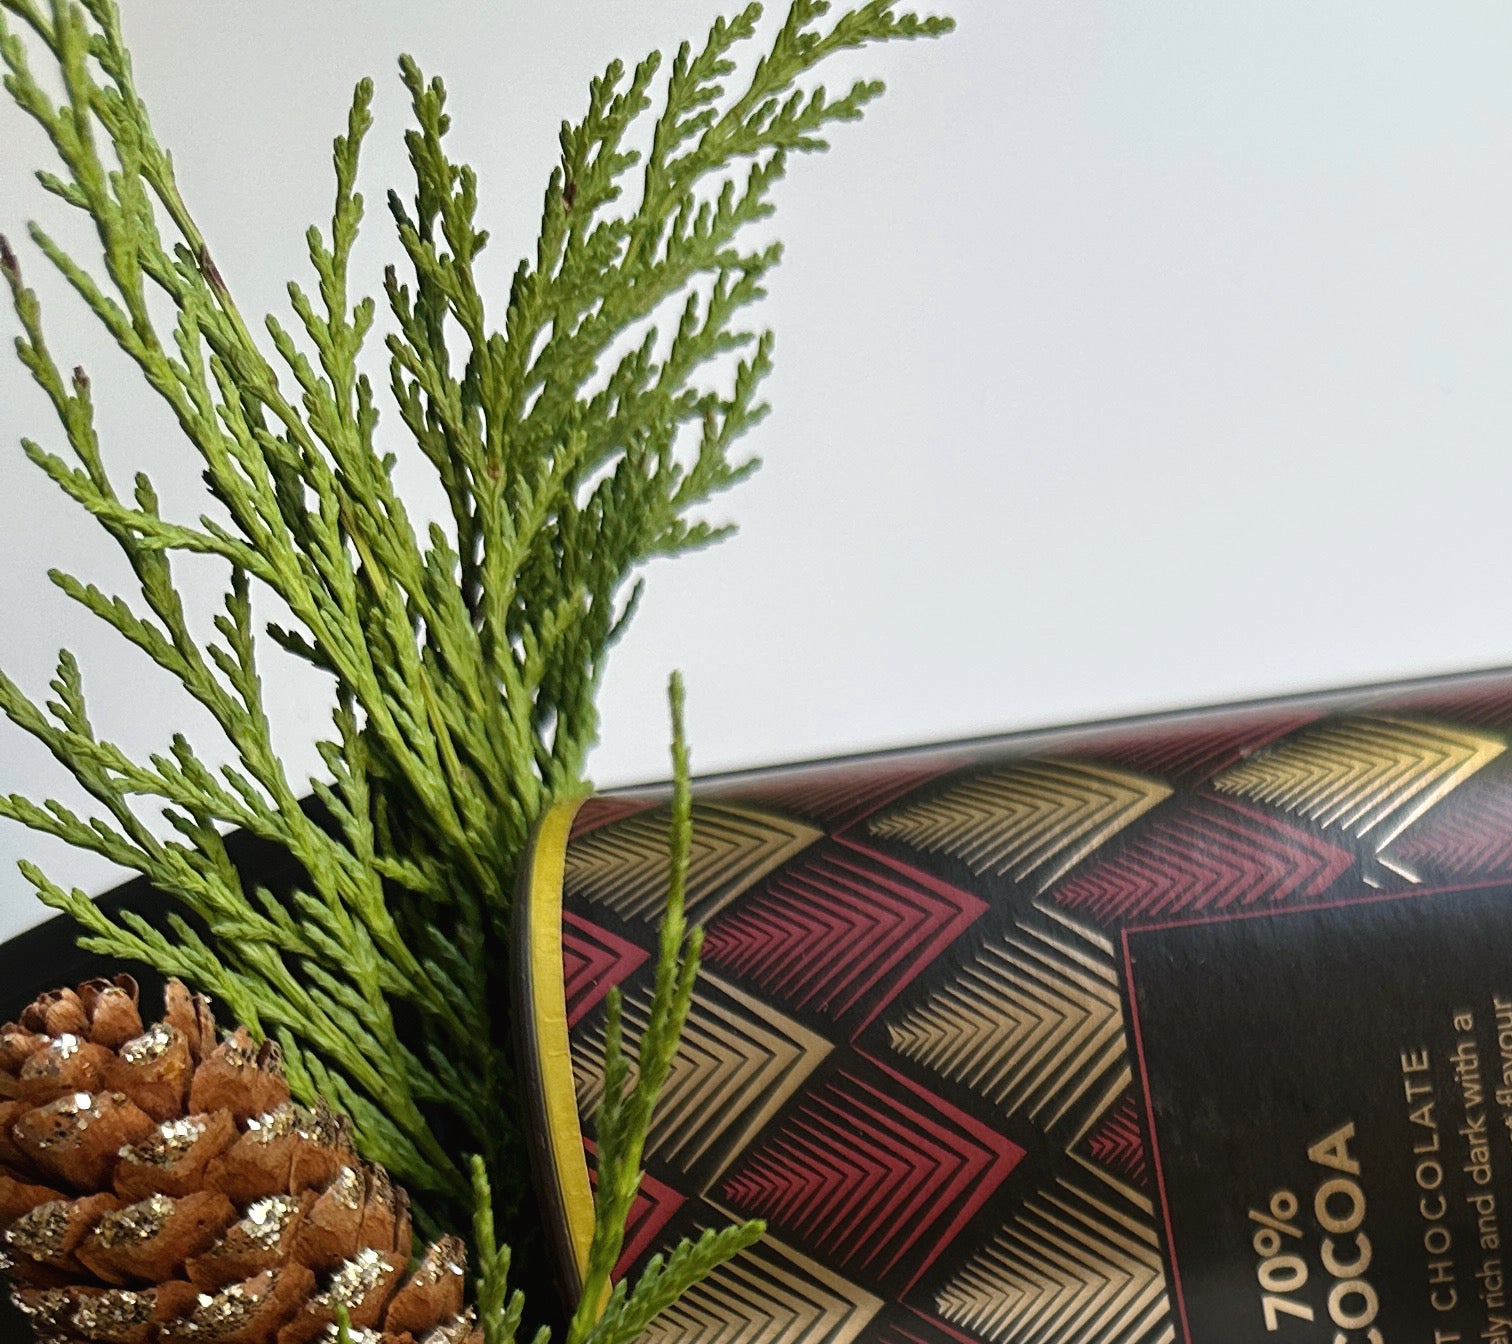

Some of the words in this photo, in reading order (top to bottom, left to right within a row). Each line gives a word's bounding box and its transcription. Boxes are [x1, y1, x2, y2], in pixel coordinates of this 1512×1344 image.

[1454, 1011, 1473, 1031] a
[1450, 1041, 1482, 1109] with
[1401, 1048, 1457, 1311] CHOCOLATE
[1459, 1113, 1492, 1185] dark
[1467, 1194, 1500, 1249] and
[1248, 1190, 1314, 1331] 70%
[1475, 1259, 1504, 1308] rich
